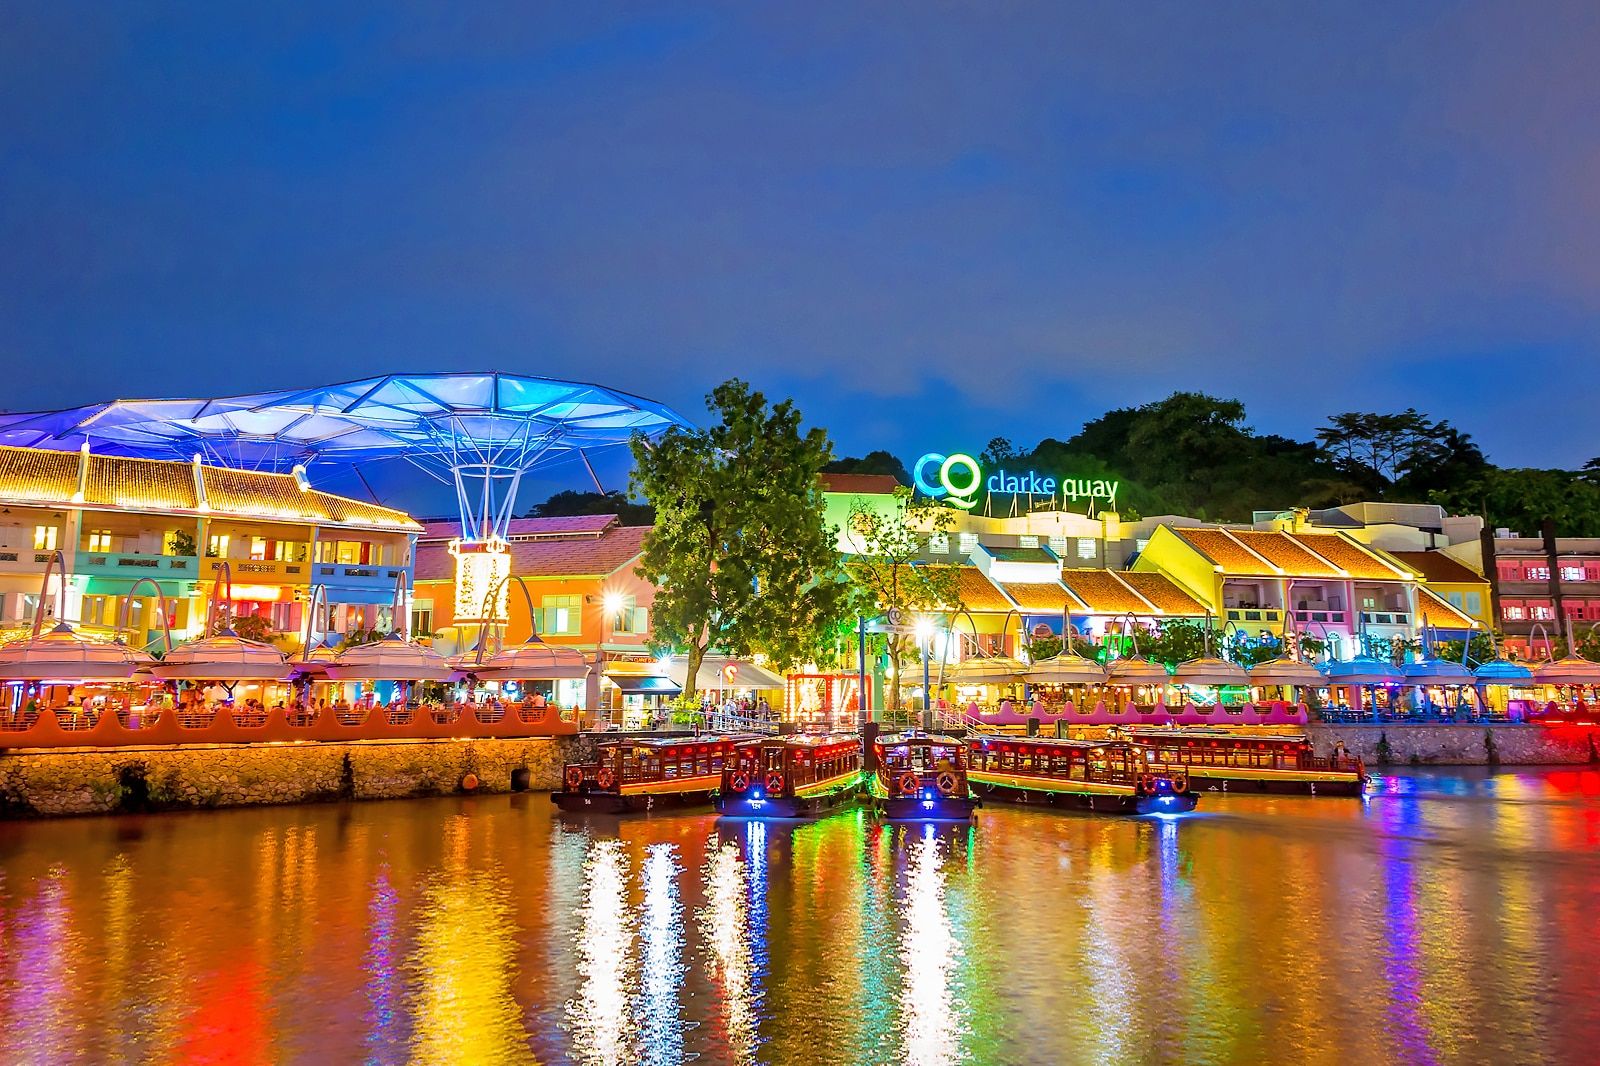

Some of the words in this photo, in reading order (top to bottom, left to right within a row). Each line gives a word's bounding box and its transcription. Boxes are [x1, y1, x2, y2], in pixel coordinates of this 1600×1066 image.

[913, 452, 982, 509] CQ
[986, 469, 1055, 494] clarke
[1062, 478, 1119, 503] quay
